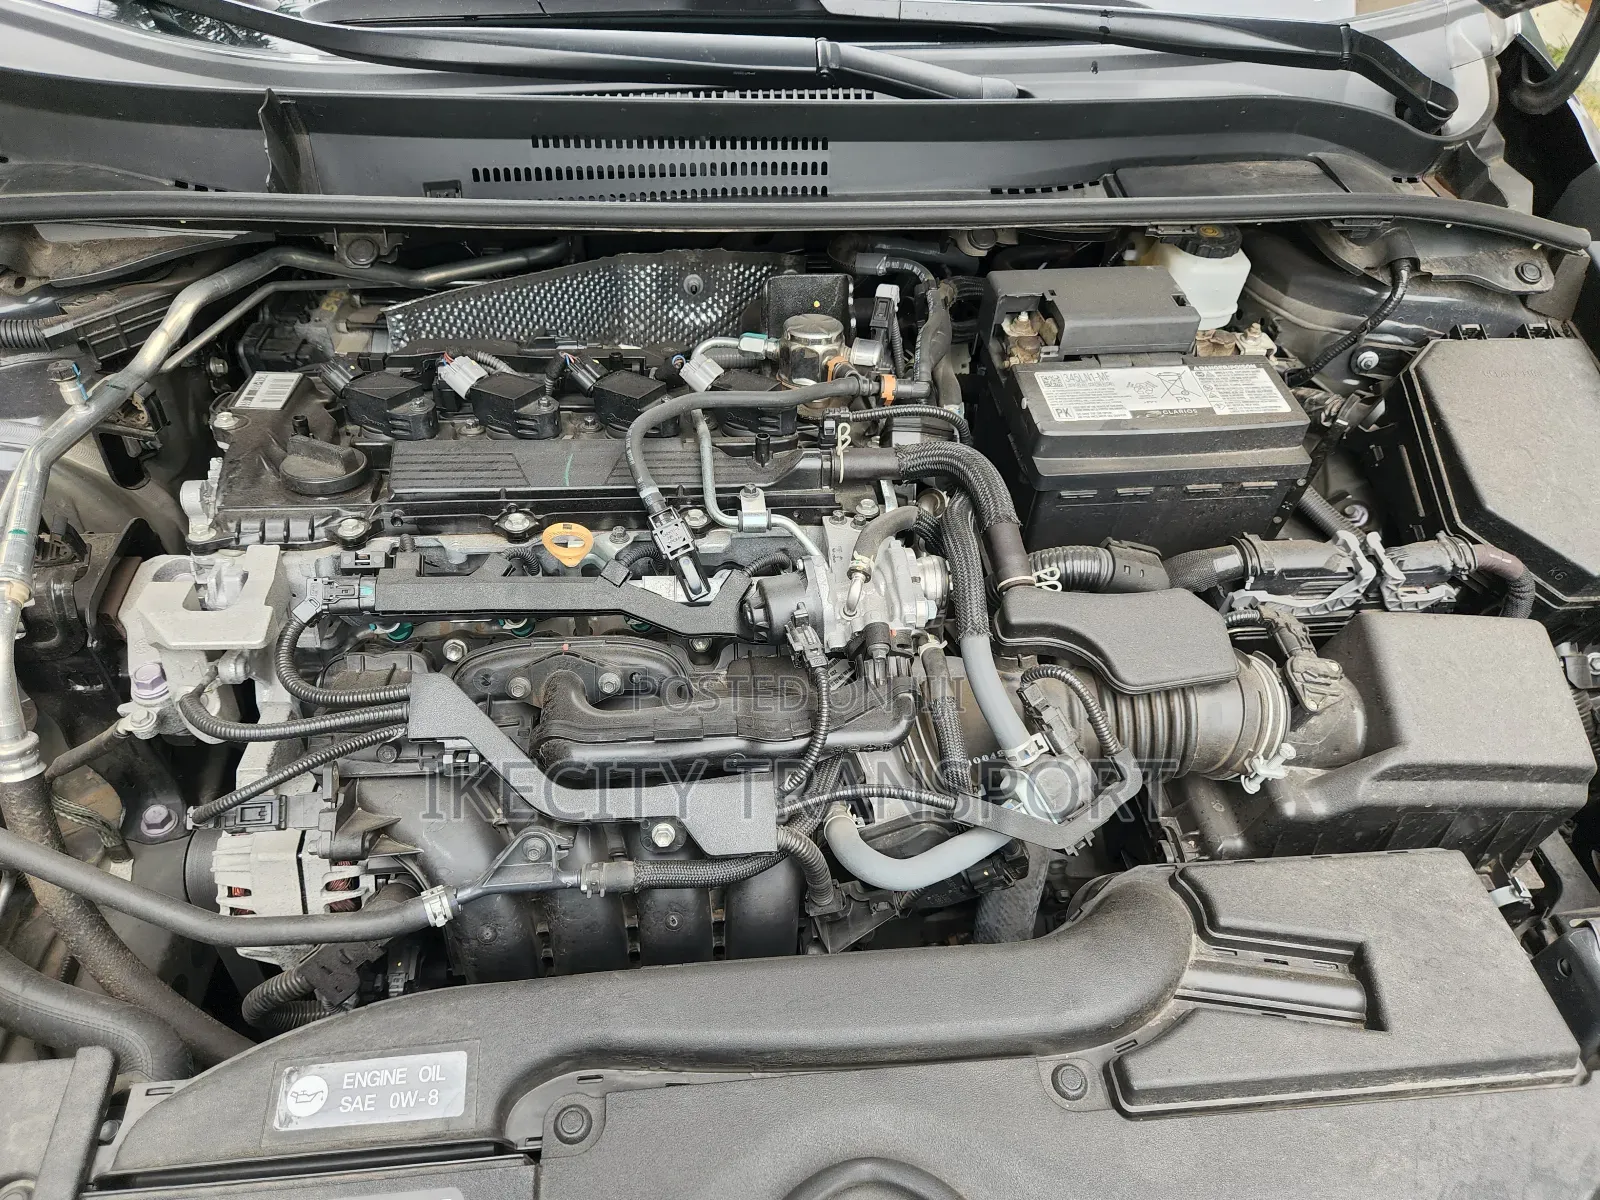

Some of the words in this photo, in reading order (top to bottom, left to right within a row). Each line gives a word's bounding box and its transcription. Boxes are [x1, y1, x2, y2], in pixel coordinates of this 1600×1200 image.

[1175, 396, 1191, 404] Pb
[1055, 408, 1072, 418] PK
[342, 1067, 408, 1090] ENGINE
[418, 1064, 446, 1083] OIL
[339, 1094, 377, 1113] SAE
[389, 1088, 439, 1109] 0W-8
